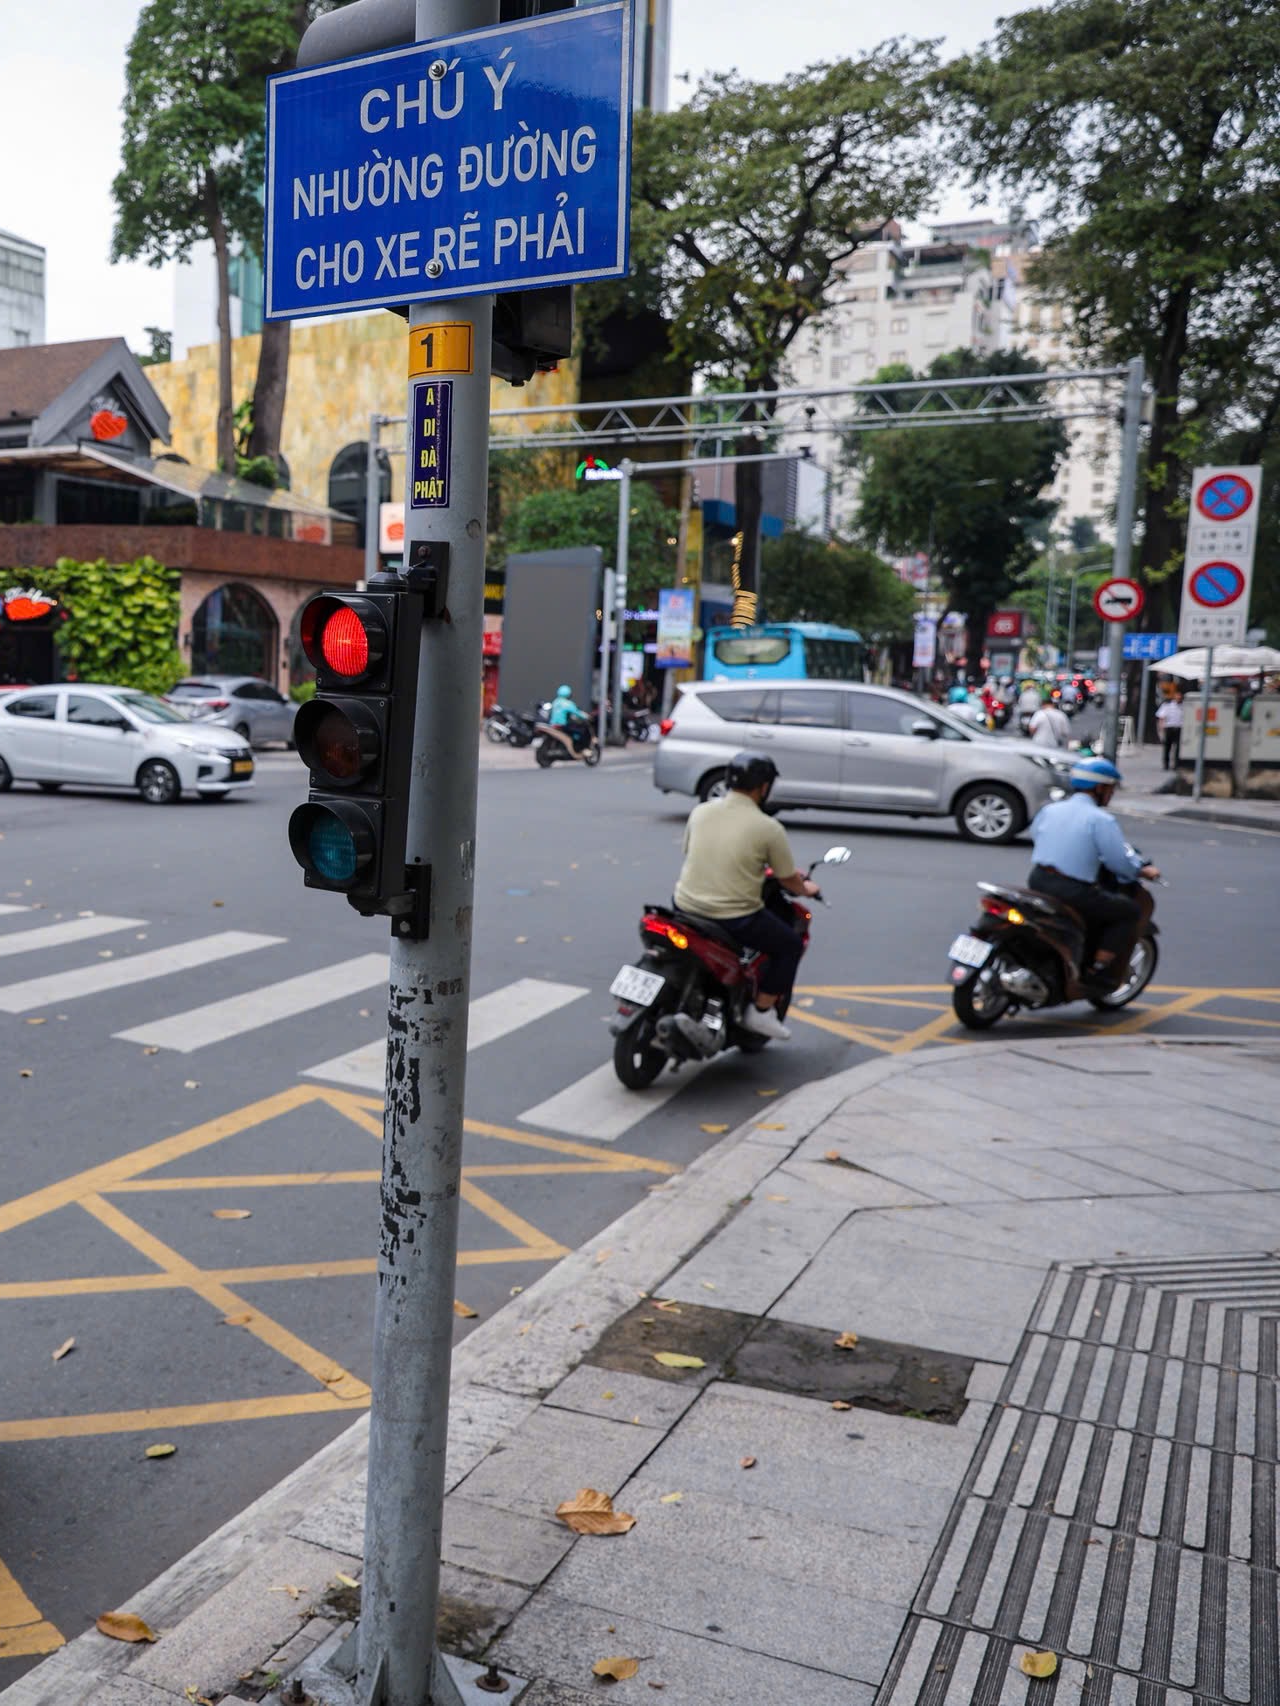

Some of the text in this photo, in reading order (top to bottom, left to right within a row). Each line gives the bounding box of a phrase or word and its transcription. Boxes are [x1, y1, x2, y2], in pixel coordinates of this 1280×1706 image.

[360, 47, 516, 133] CHÚ Ý
[293, 121, 597, 219] NHƯỜNG ĐƯỜNG
[295, 192, 585, 290] CHO XE RẼ PHẢI
[420, 333, 433, 368] 1
[425, 387, 434, 405] A
[423, 418, 436, 437] DI
[420, 445, 437, 468] ĐÀ
[414, 476, 444, 502] PHẬT
